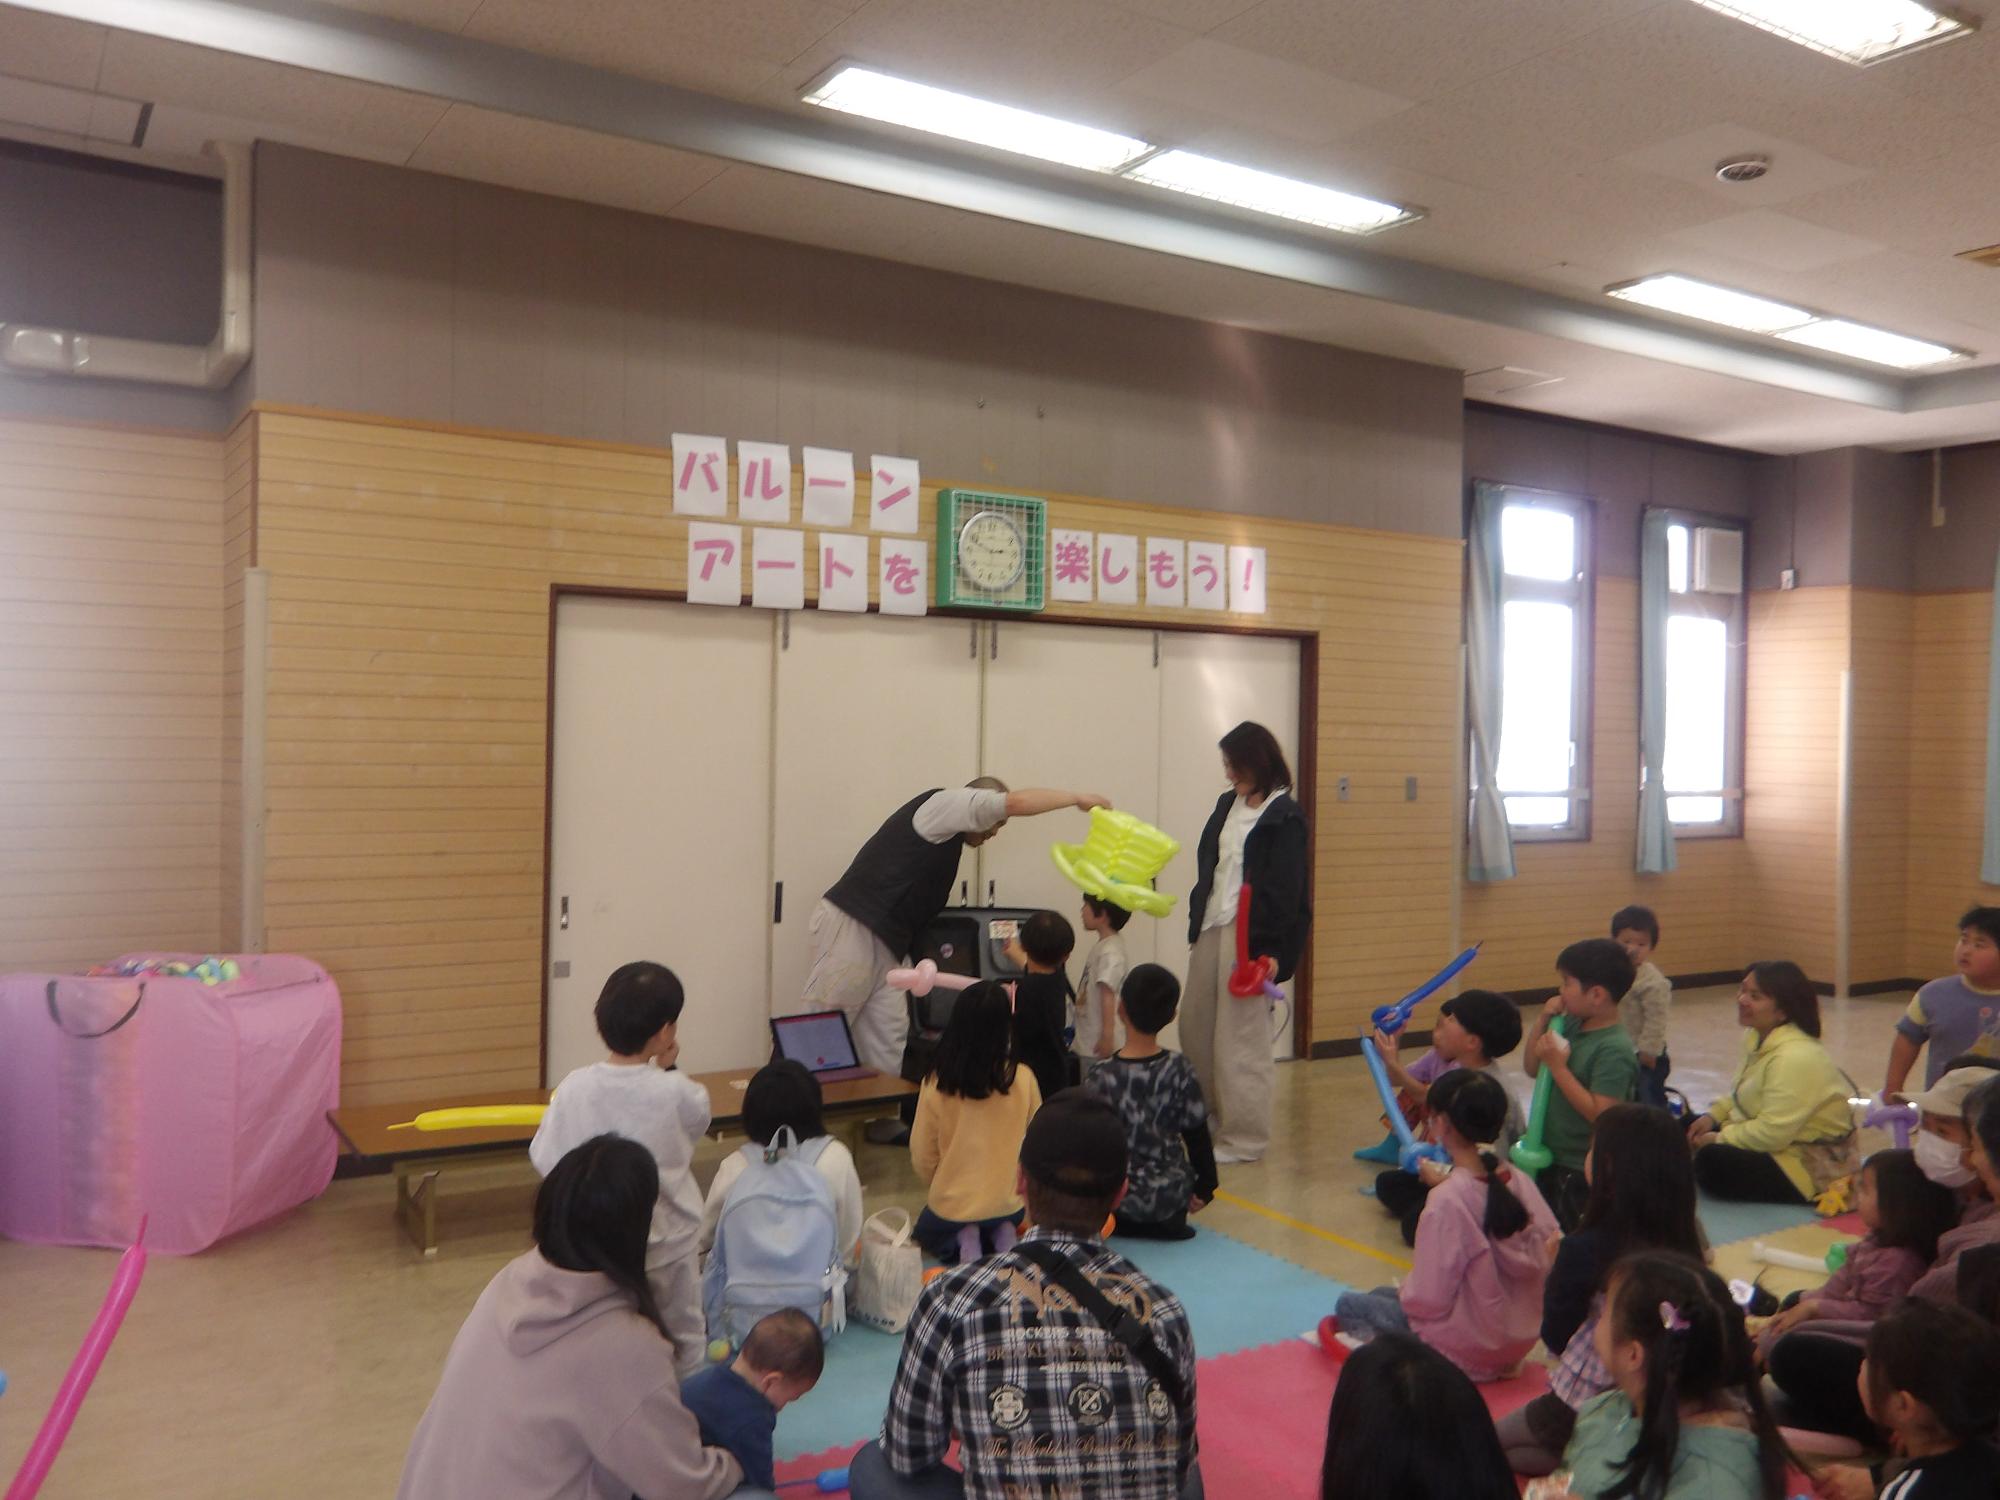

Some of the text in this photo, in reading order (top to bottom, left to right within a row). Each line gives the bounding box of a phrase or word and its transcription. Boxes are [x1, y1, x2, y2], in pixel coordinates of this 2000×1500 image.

[679, 451, 911, 511] バルーン
[694, 539, 919, 595] アートを
